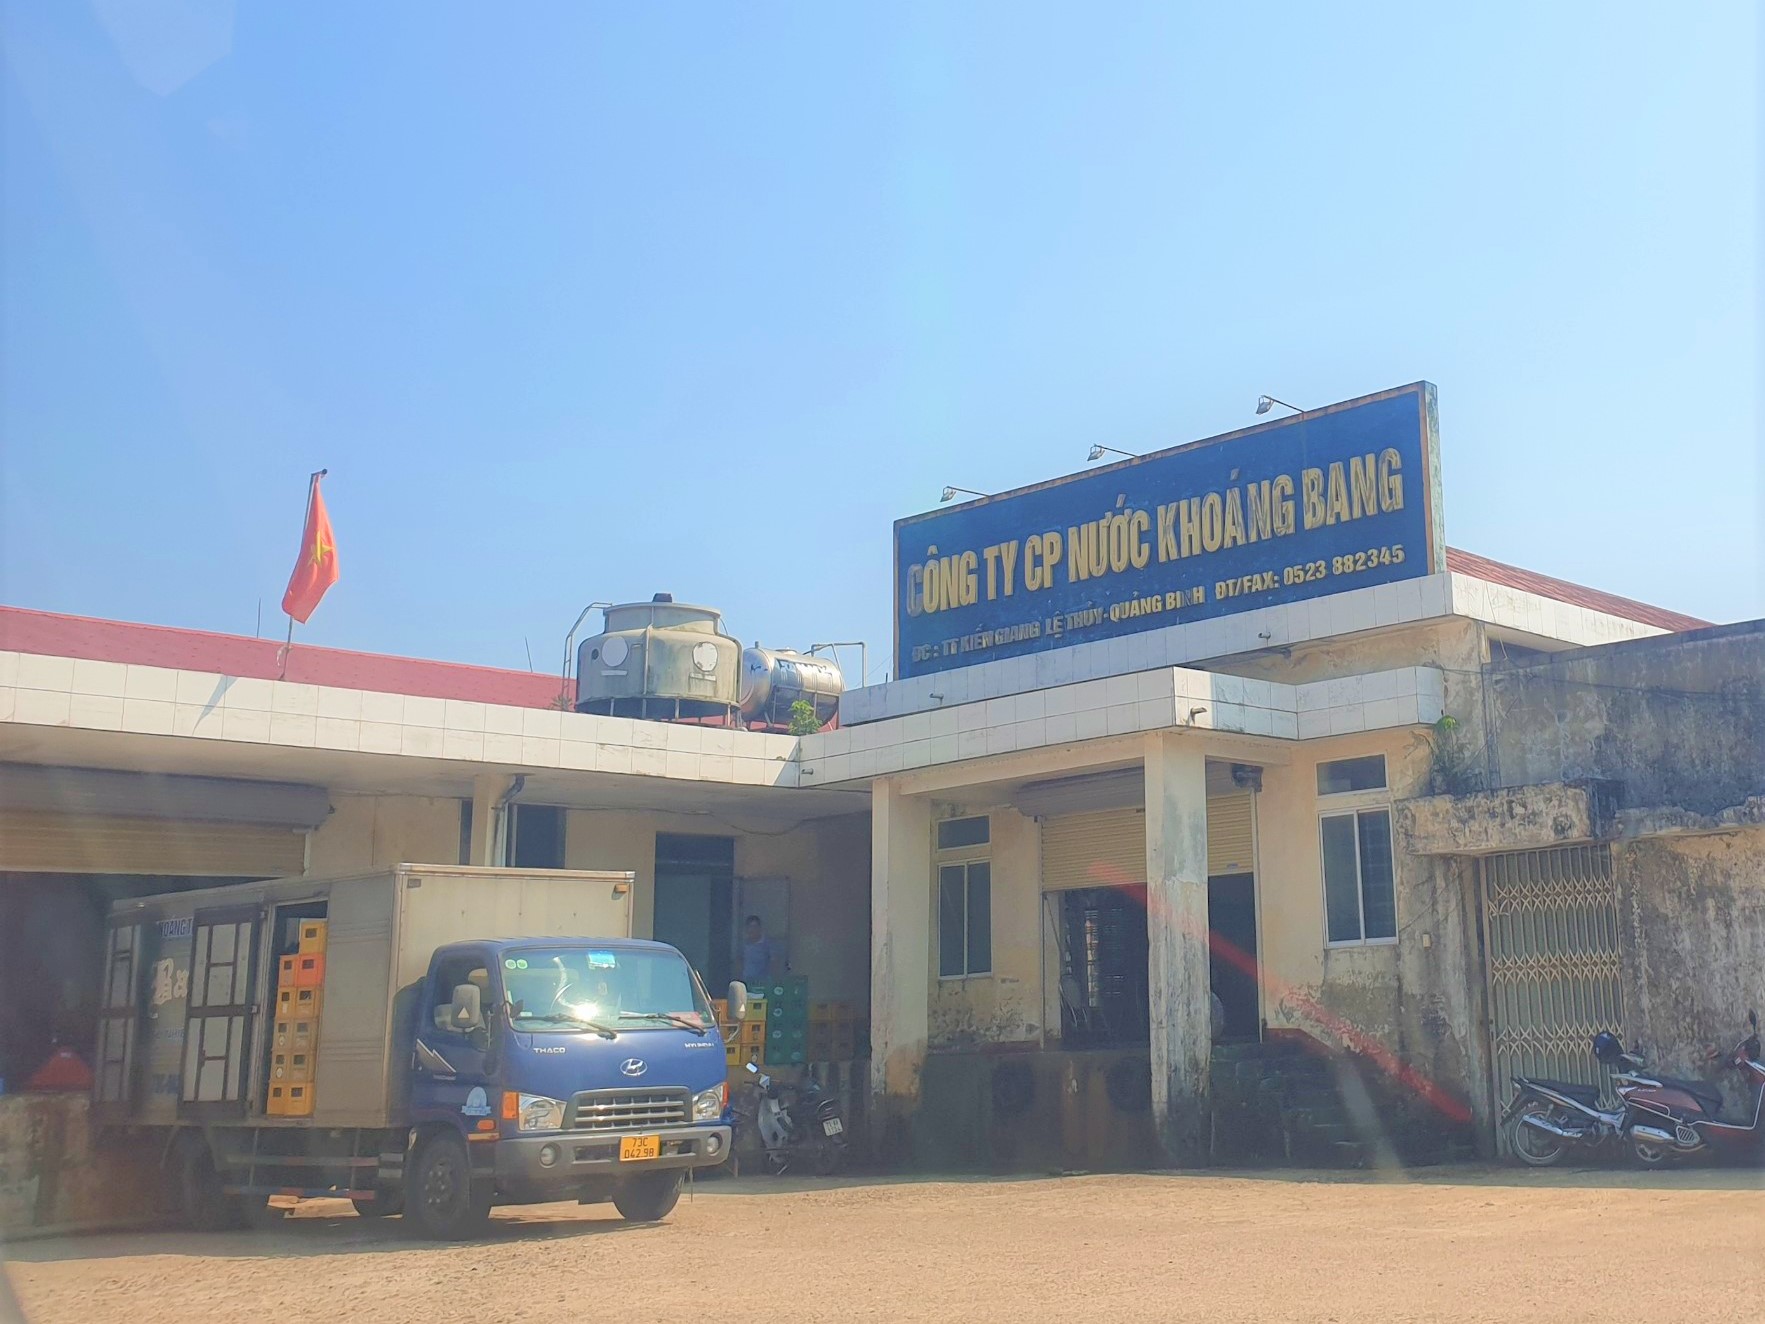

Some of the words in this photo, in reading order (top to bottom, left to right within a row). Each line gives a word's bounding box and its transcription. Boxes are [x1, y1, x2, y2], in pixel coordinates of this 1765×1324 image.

[907, 545, 978, 617] CÔNG
[984, 540, 1019, 600] TY
[1025, 532, 1062, 591] CP
[1068, 494, 1150, 582] NƯỚC
[1157, 468, 1296, 562] KHOÁNG
[1302, 448, 1404, 530] BANG
[995, 621, 1041, 645] GIANG
[1283, 560, 1326, 585] 0523
[1332, 544, 1405, 575] 882345
[624, 1147, 655, 1159] 042.98
[632, 1136, 648, 1148] 73C
